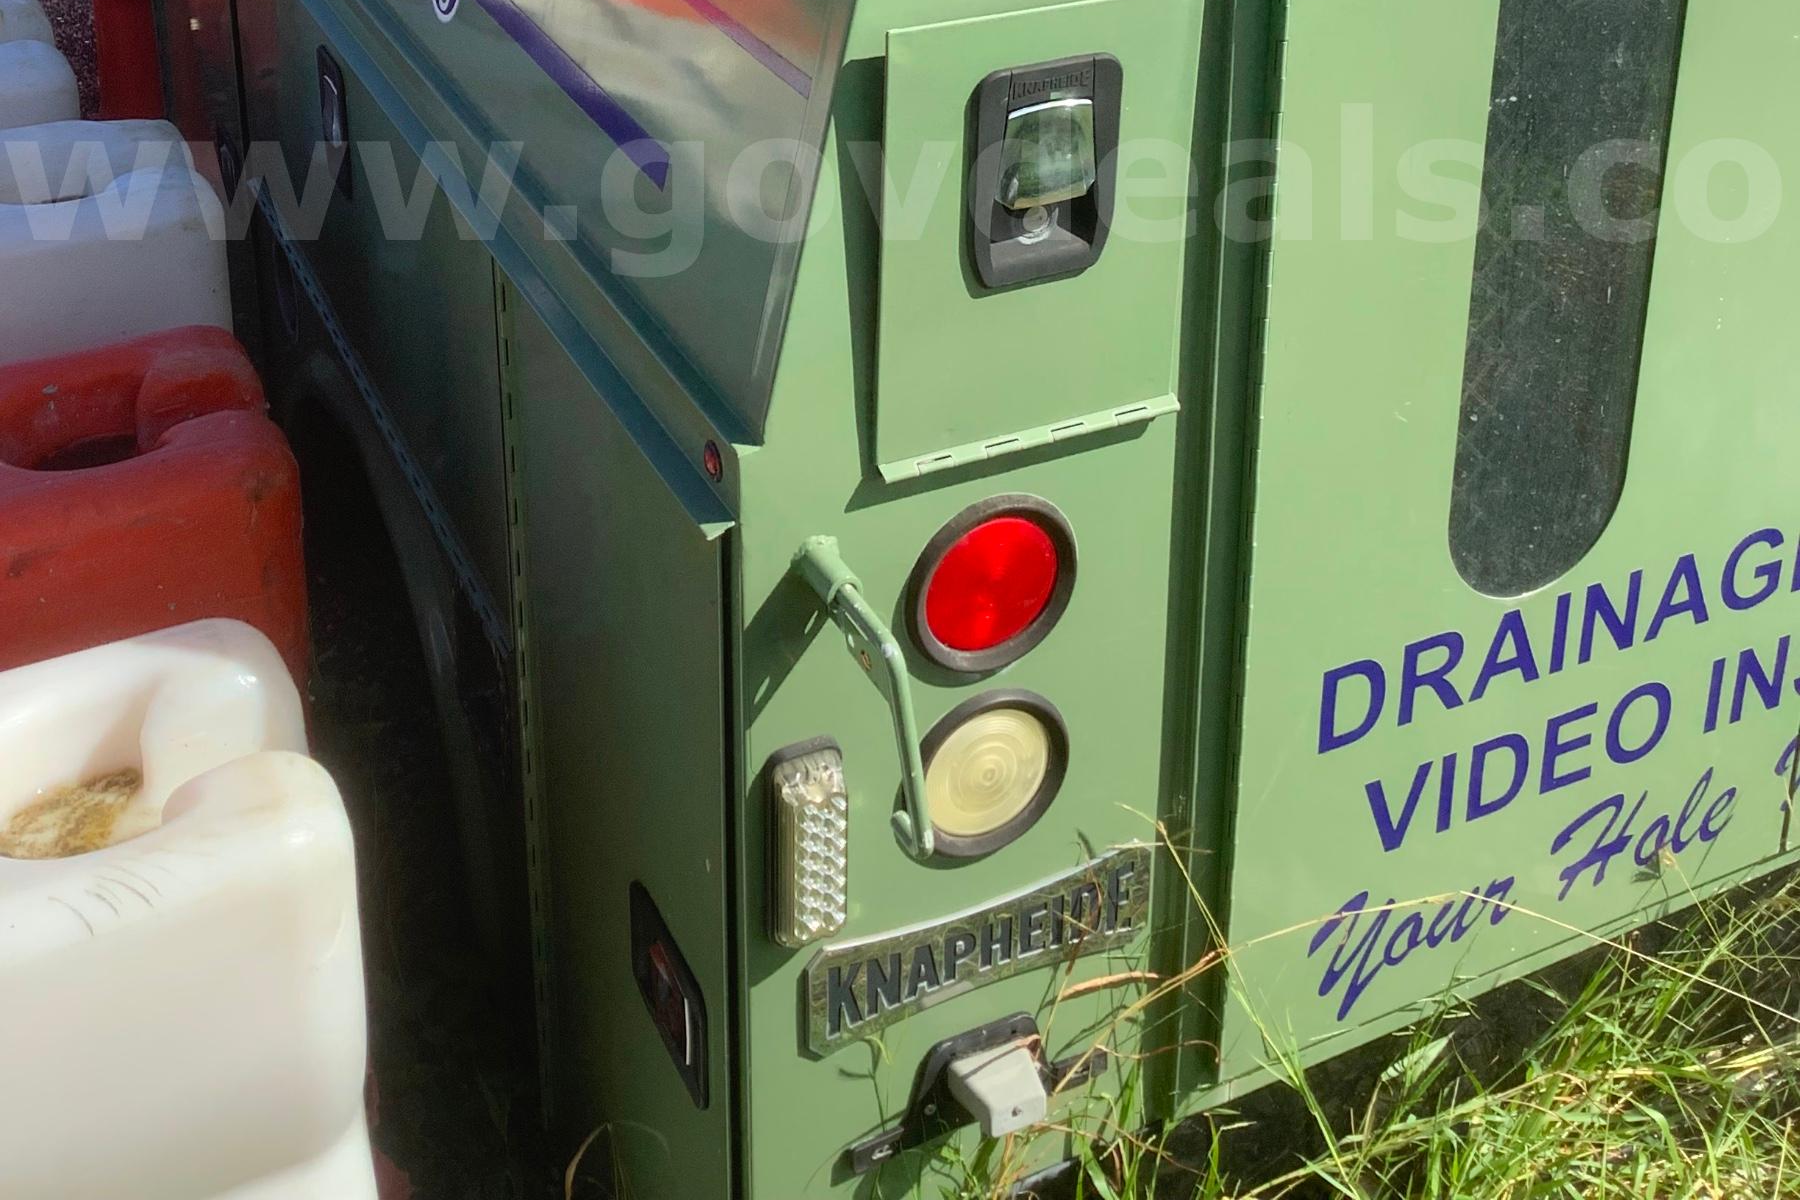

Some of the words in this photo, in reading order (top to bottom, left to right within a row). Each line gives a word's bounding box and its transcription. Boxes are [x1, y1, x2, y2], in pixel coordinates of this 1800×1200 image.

[1317, 527, 1800, 755] DRAINAG
[1364, 681, 1673, 853] VIDEO
[1703, 633, 1800, 735] IN
[825, 860, 1137, 1039] KNAPHEIDE
[1306, 874, 1517, 1023] Your
[1550, 765, 1738, 902] Hole
